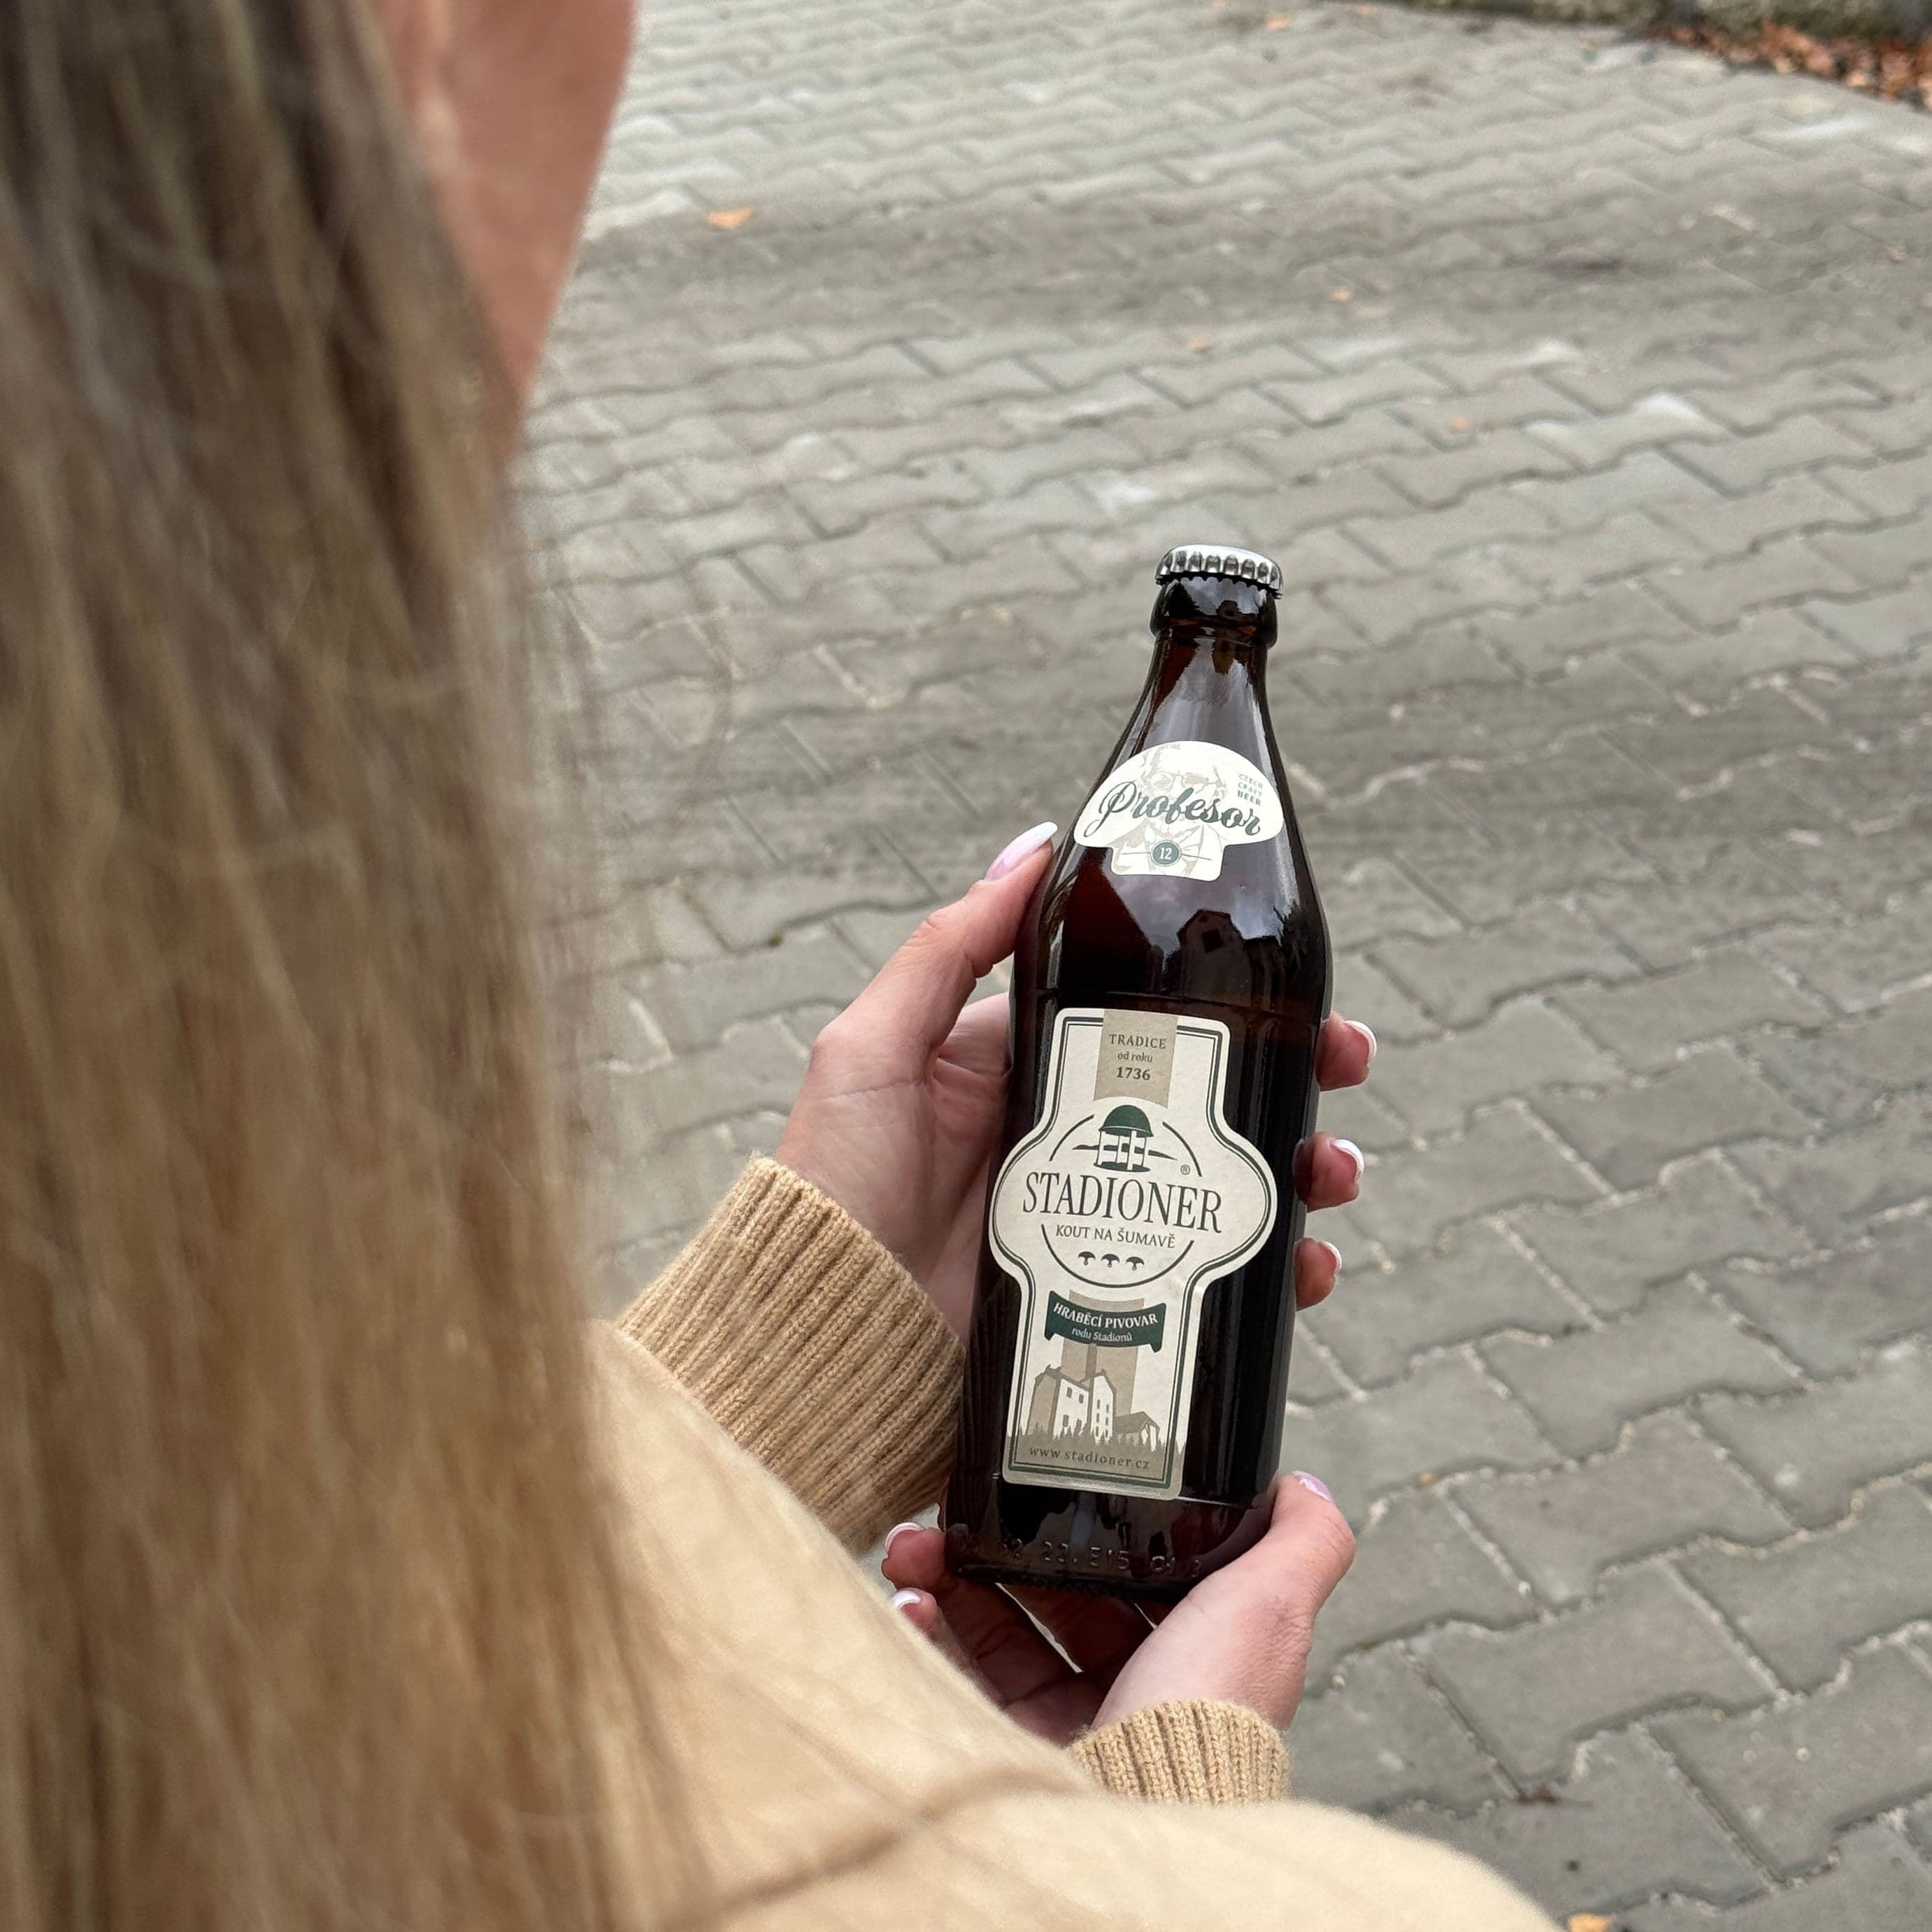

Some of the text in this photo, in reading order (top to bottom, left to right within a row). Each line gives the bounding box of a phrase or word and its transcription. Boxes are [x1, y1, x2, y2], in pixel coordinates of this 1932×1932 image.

[1237, 789, 1261, 806] BEER
[1084, 781, 1261, 836] Profesor
[1159, 846, 1173, 861] 12
[1108, 1033, 1166, 1050] TRADICE
[1117, 1051, 1153, 1063] od roku
[1116, 1066, 1151, 1081] 1736
[1022, 1171, 1222, 1234] STADIONER
[1056, 1224, 1176, 1249] KOUT NA ŠUMAVĚ
[1052, 1301, 1159, 1329] HRABĚCÍ PIVOVAR
[1071, 1327, 1133, 1343] rodu Stadionů
[1029, 1447, 1150, 1470] www.stadioner.cz
